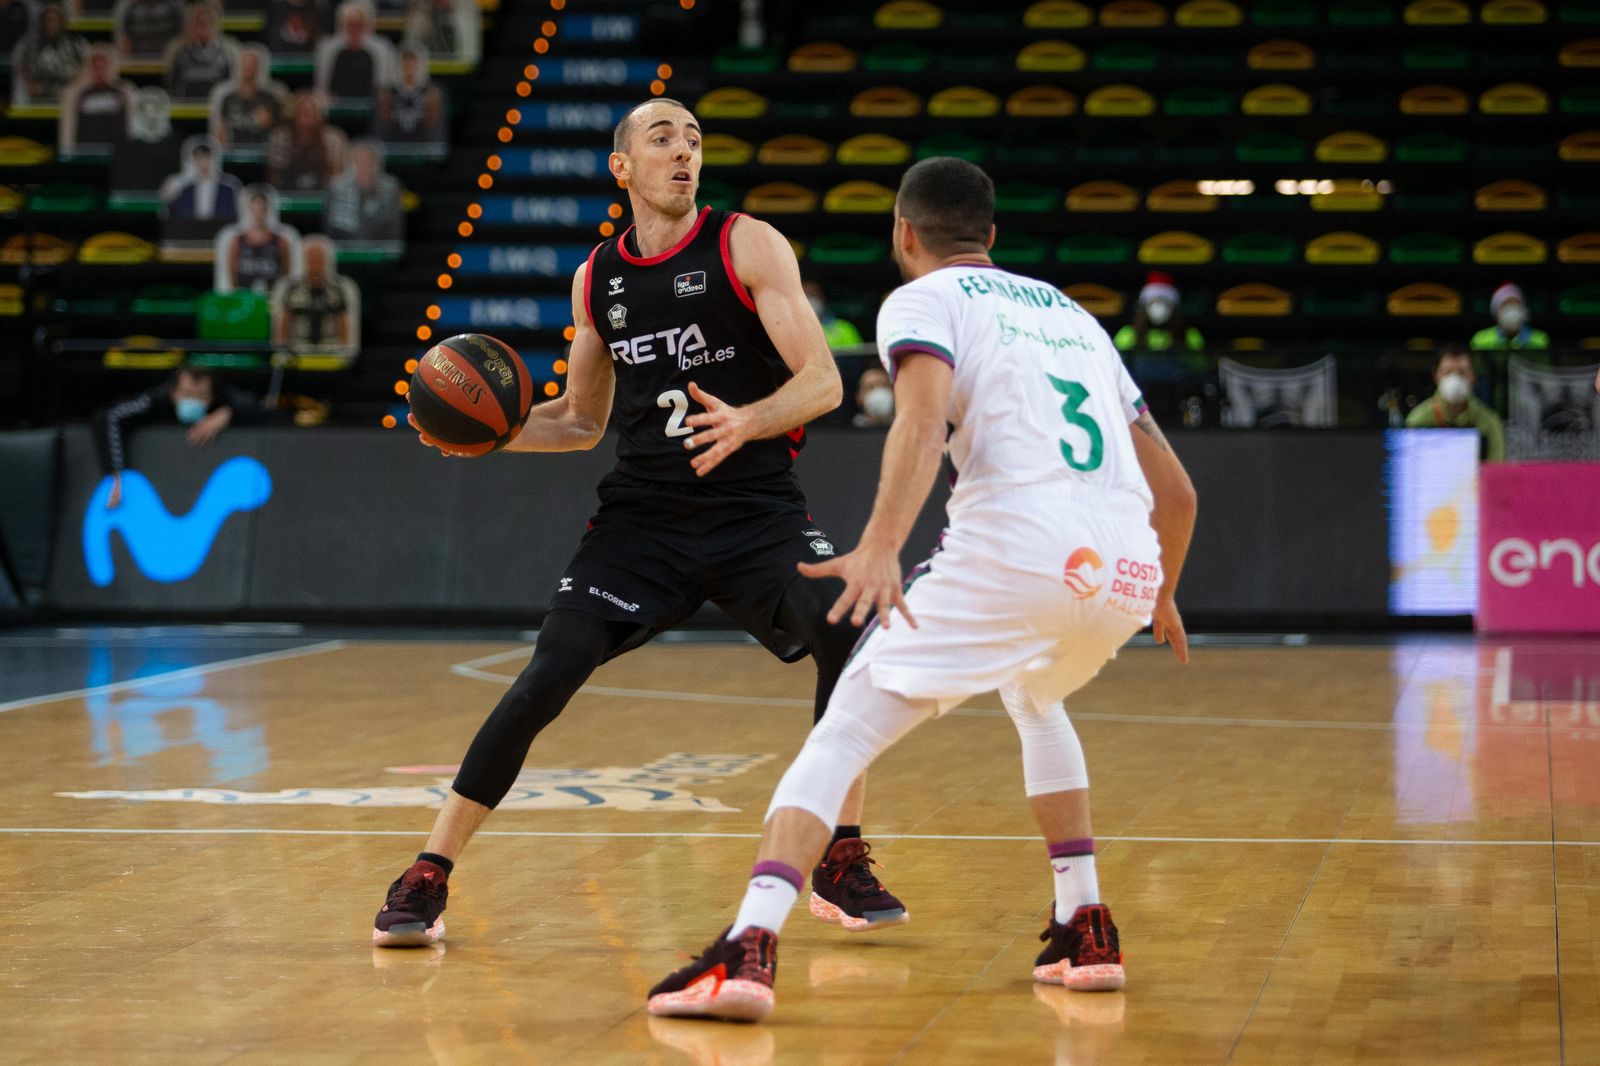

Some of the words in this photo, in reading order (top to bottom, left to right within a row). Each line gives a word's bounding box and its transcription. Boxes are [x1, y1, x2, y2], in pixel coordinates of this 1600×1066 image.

[609, 323, 707, 368] RETA
[681, 346, 735, 371] bet.es
[430, 346, 488, 405] SPALDIN
[656, 389, 695, 438] 2
[1046, 372, 1104, 471] 3
[1488, 537, 1600, 588] en
[589, 586, 601, 596] EL
[602, 591, 636, 612] CORREO
[1110, 578, 1138, 599] DEL
[1140, 586, 1156, 600] SO
